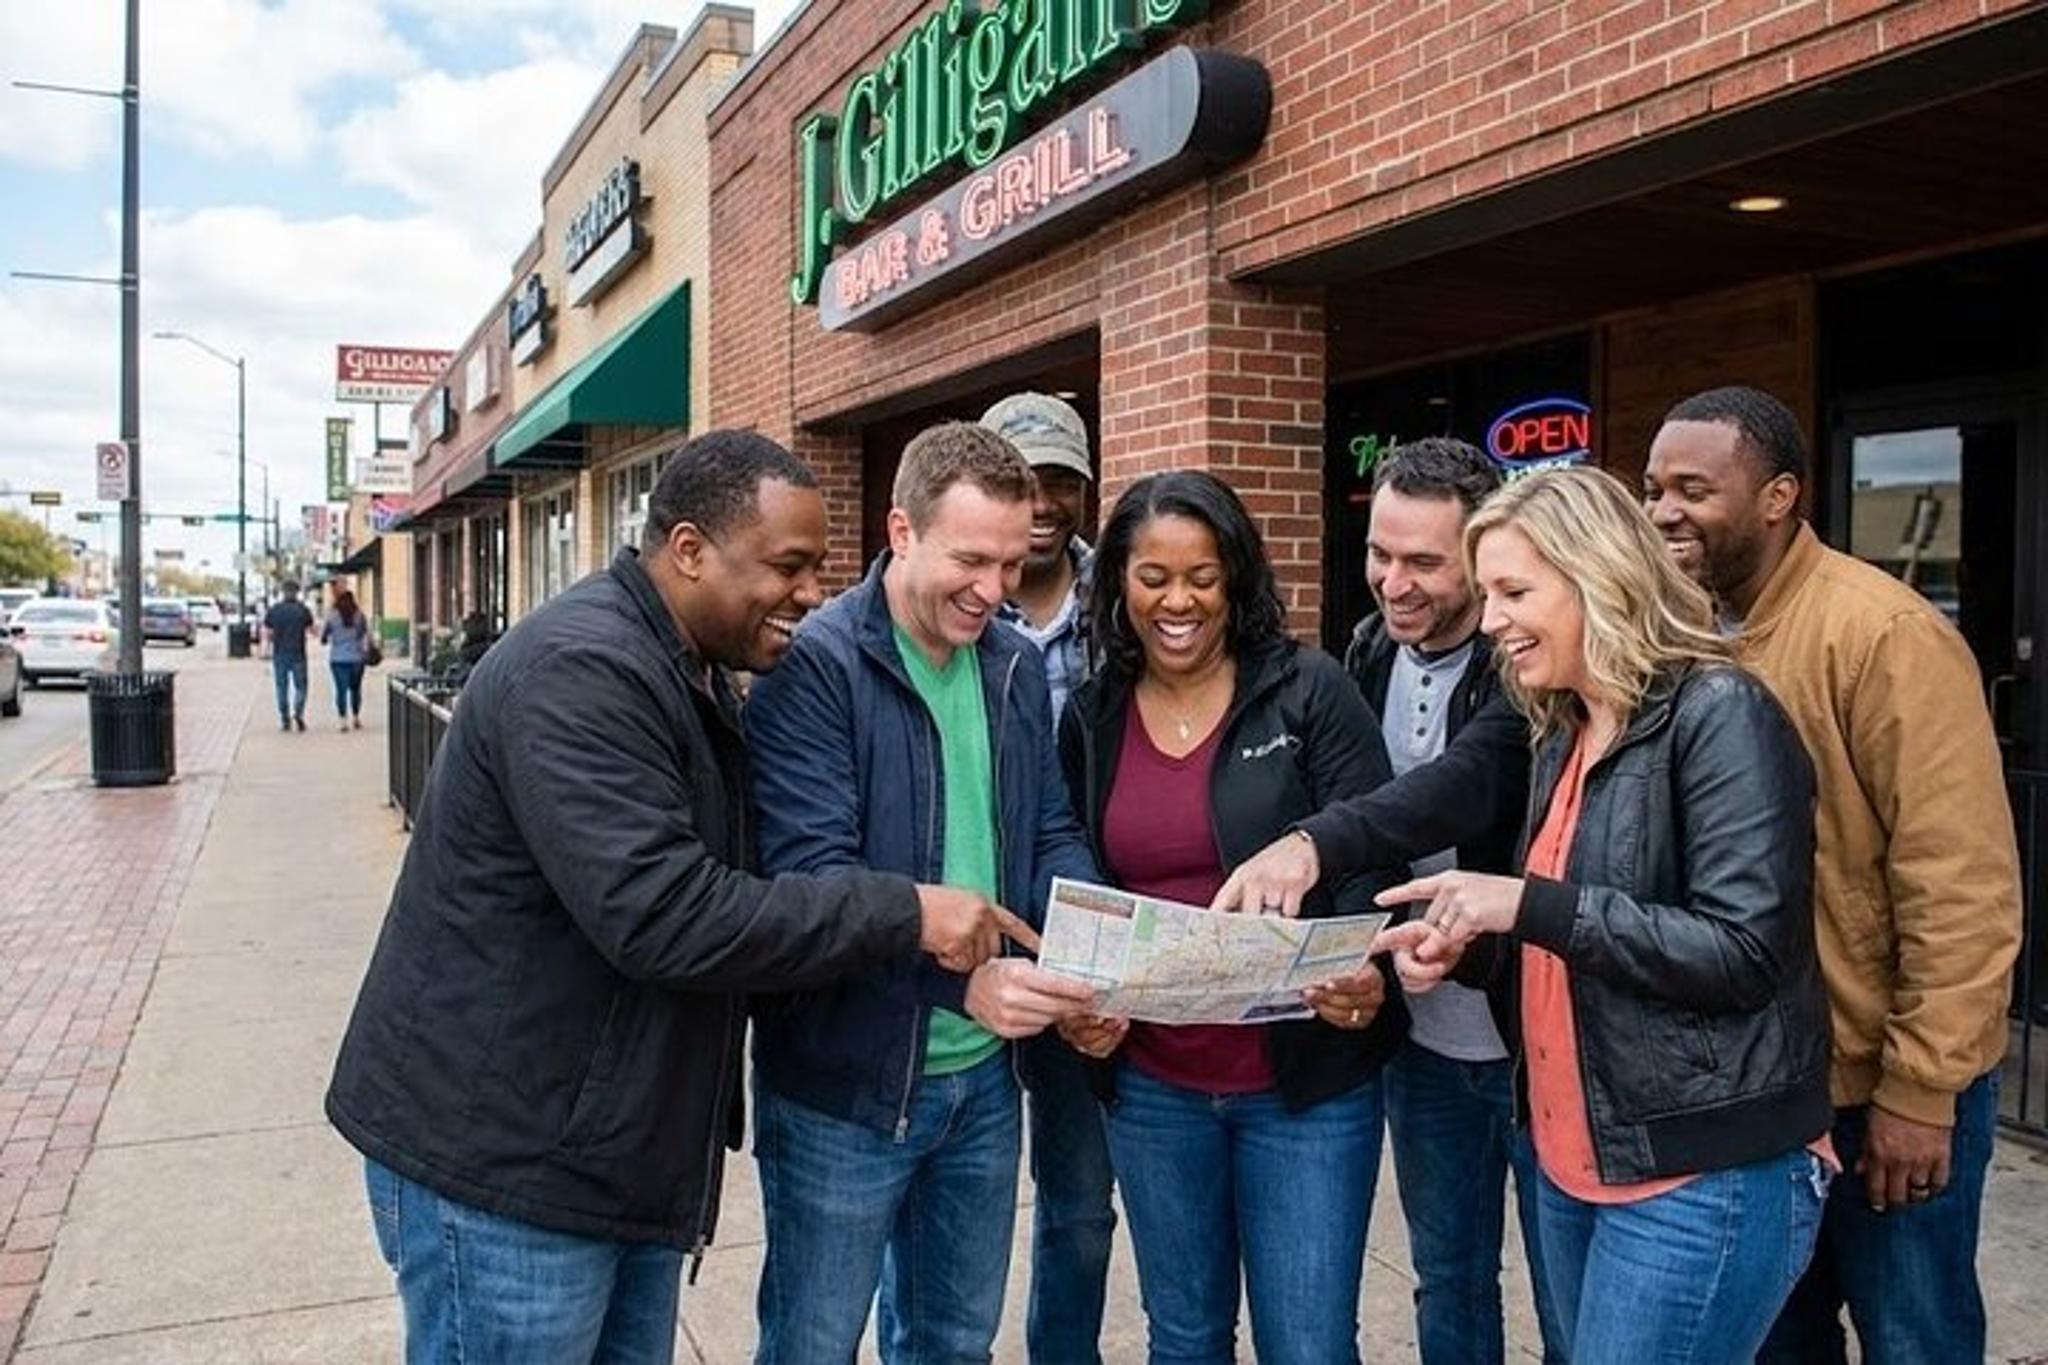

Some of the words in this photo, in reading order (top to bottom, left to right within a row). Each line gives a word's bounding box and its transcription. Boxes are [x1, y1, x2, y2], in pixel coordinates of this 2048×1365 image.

[835, 229, 910, 308] BAR
[916, 208, 950, 266] &
[959, 105, 1137, 240] GRILL
[1493, 414, 1590, 457] OPEN
